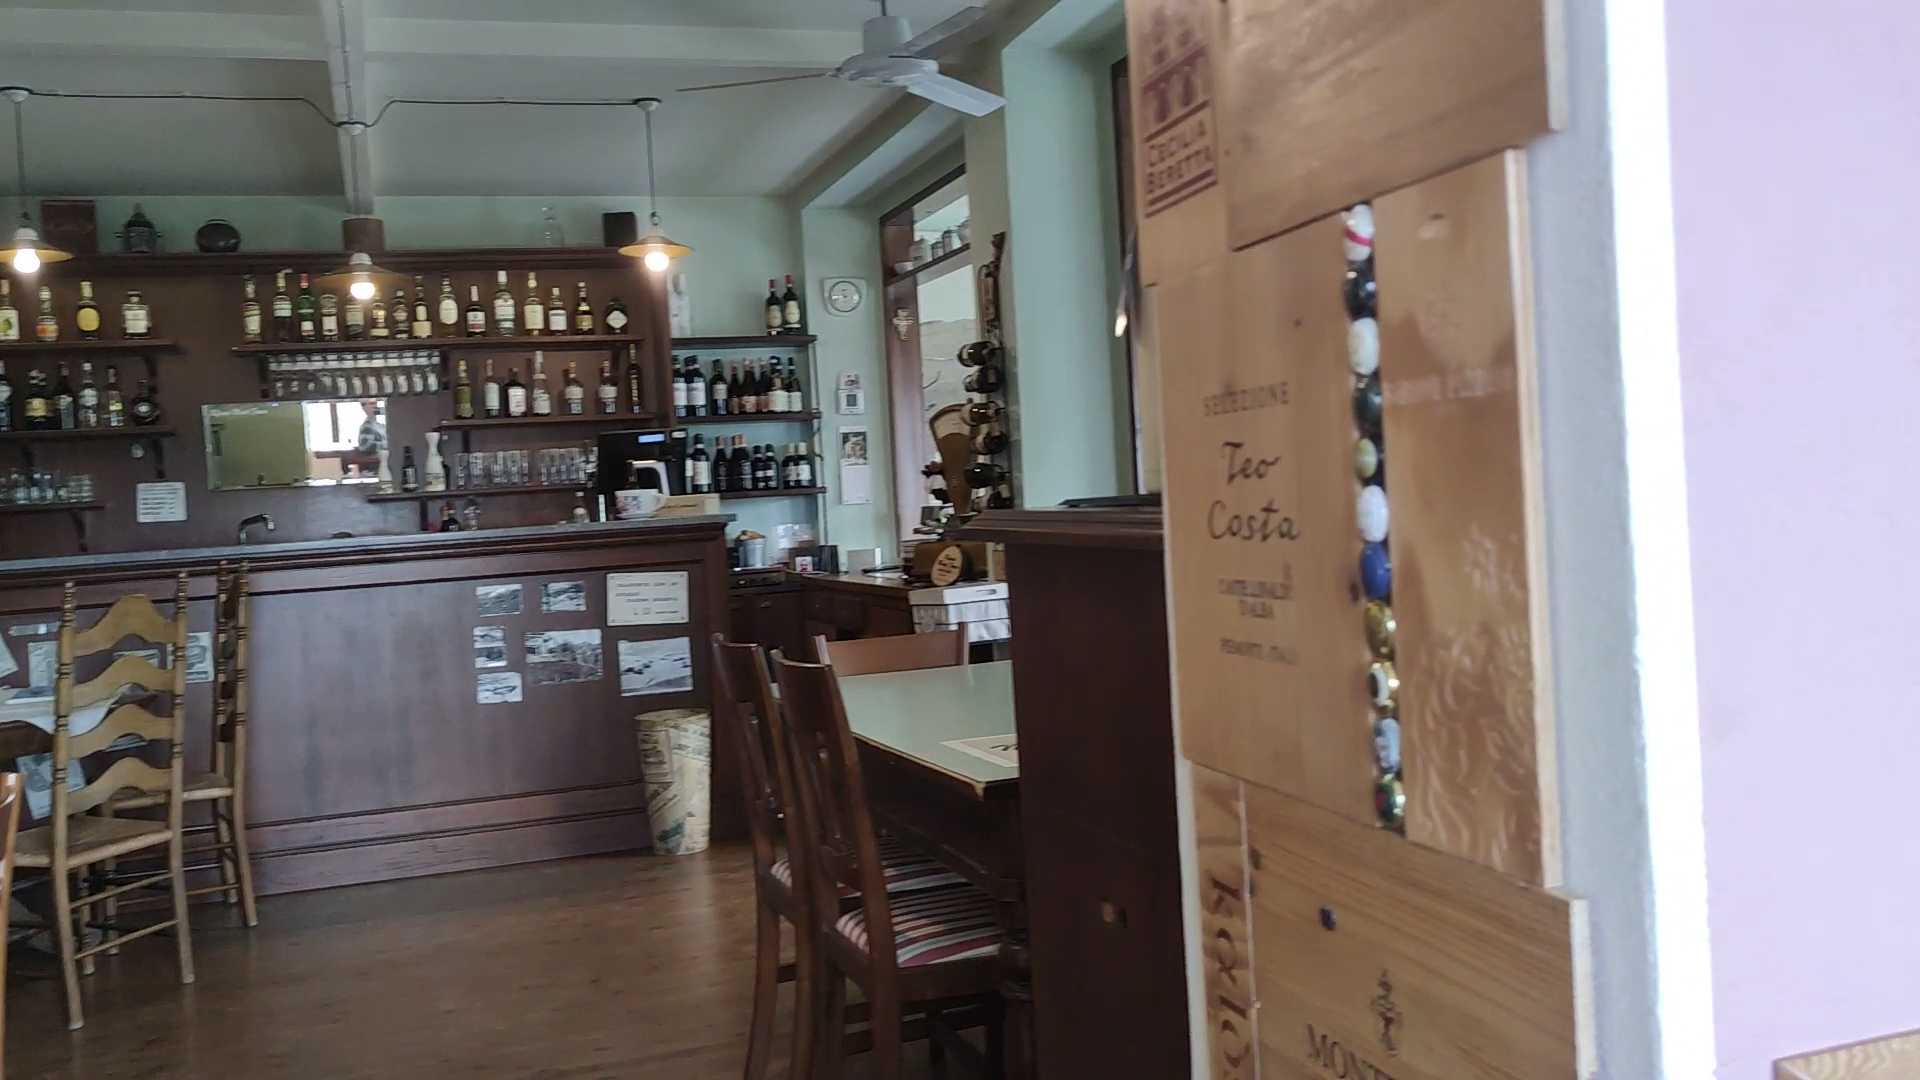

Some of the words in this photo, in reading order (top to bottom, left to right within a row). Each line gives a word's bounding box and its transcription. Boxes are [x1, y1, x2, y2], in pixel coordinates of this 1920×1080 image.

[1149, 119, 1206, 167] CECILIA
[1146, 145, 1213, 195] BERETTA
[1202, 381, 1289, 417] SELEZIONE
[1221, 441, 1281, 486] Teo
[1207, 497, 1301, 543] Costa
